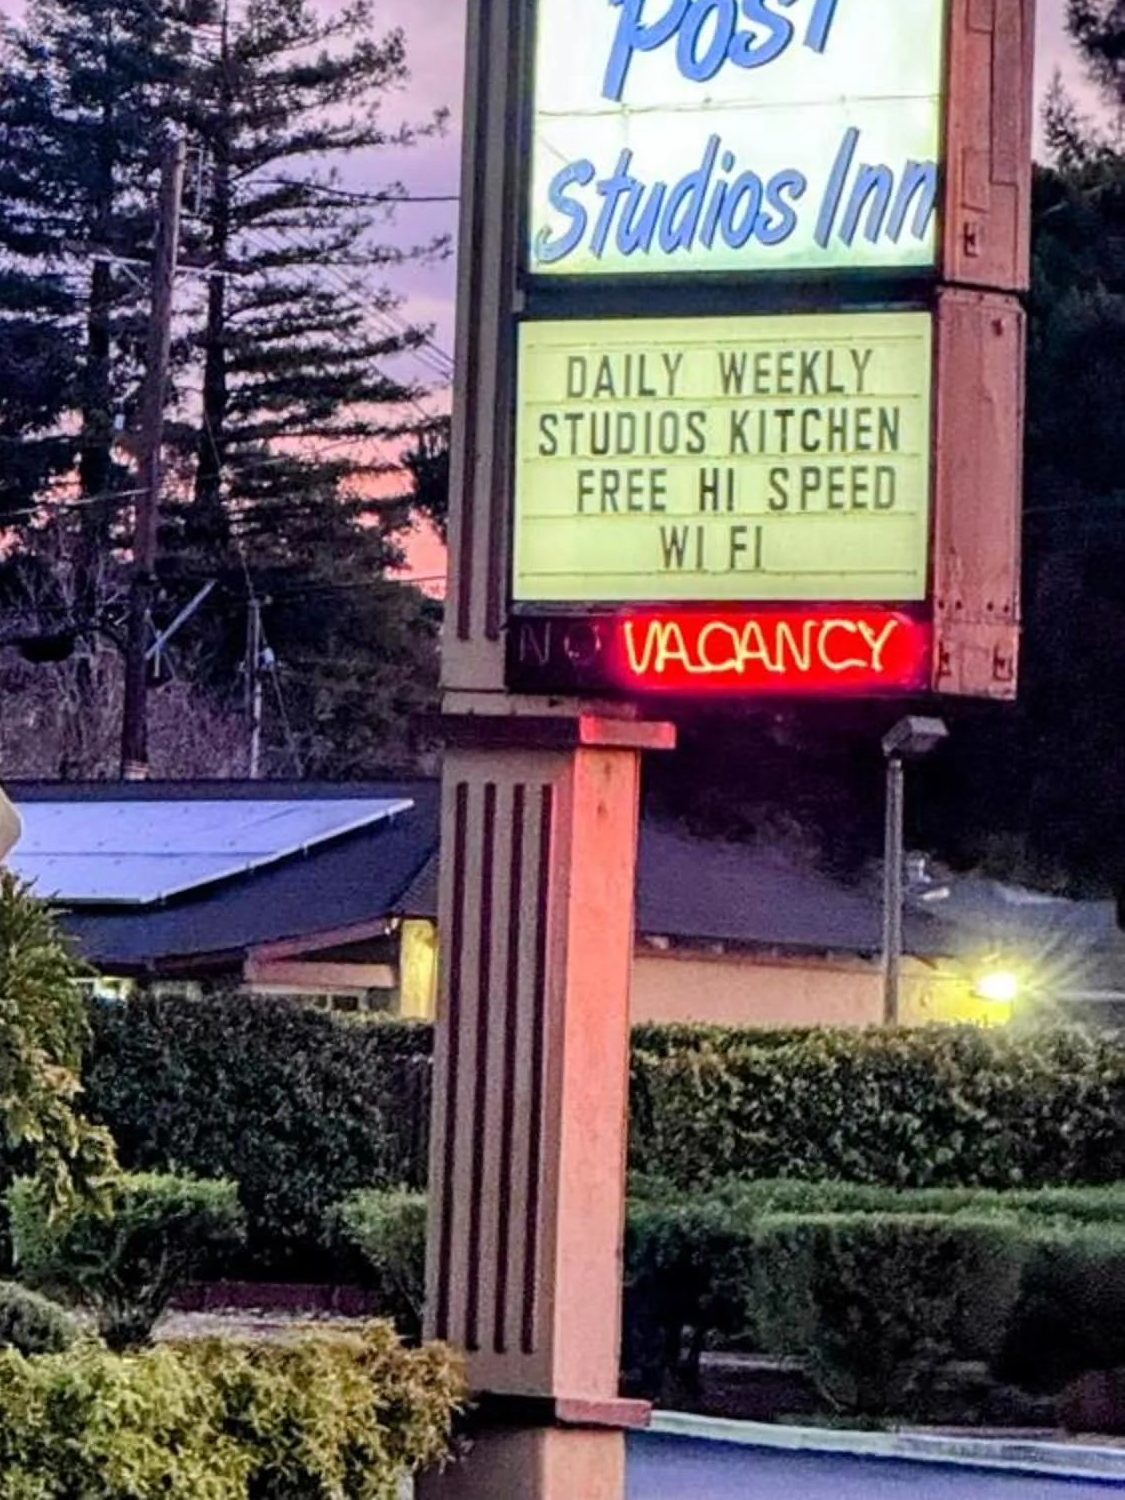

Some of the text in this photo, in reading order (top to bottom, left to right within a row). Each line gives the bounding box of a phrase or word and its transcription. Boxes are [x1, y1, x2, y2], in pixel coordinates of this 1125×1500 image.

[536, 126, 938, 265] Studios Inn
[566, 348, 873, 399] DAILY WEEKLY
[539, 406, 901, 457] STUDIOS KITCHEN
[577, 465, 896, 513] FREE HI SPEED
[624, 619, 899, 675] VACANCY
